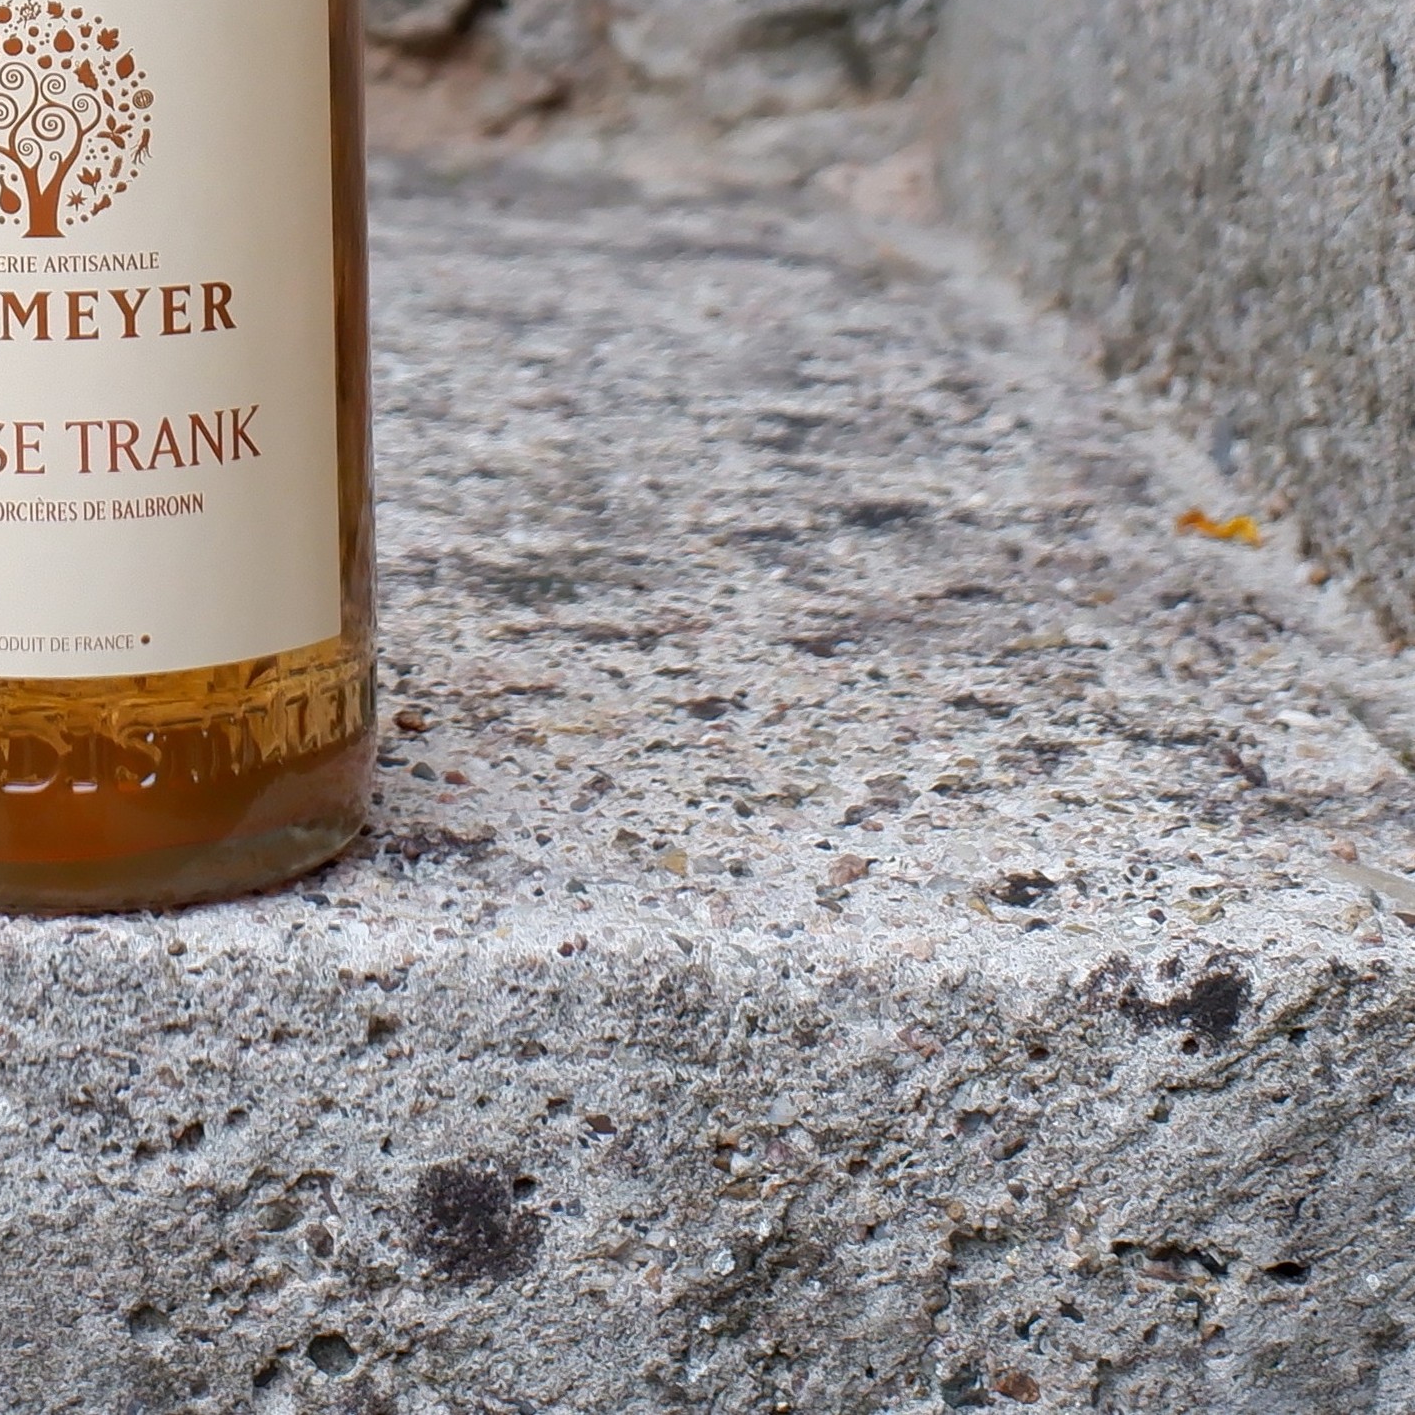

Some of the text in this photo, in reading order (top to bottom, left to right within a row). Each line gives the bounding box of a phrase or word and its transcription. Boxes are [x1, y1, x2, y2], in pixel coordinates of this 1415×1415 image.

[43, 251, 160, 274] ARTISANALE
[64, 404, 262, 474] TRANK
[83, 500, 106, 522] DE
[112, 492, 204, 521] BALBRONN
[50, 636, 70, 653] DE
[74, 634, 134, 652] FRANCE
